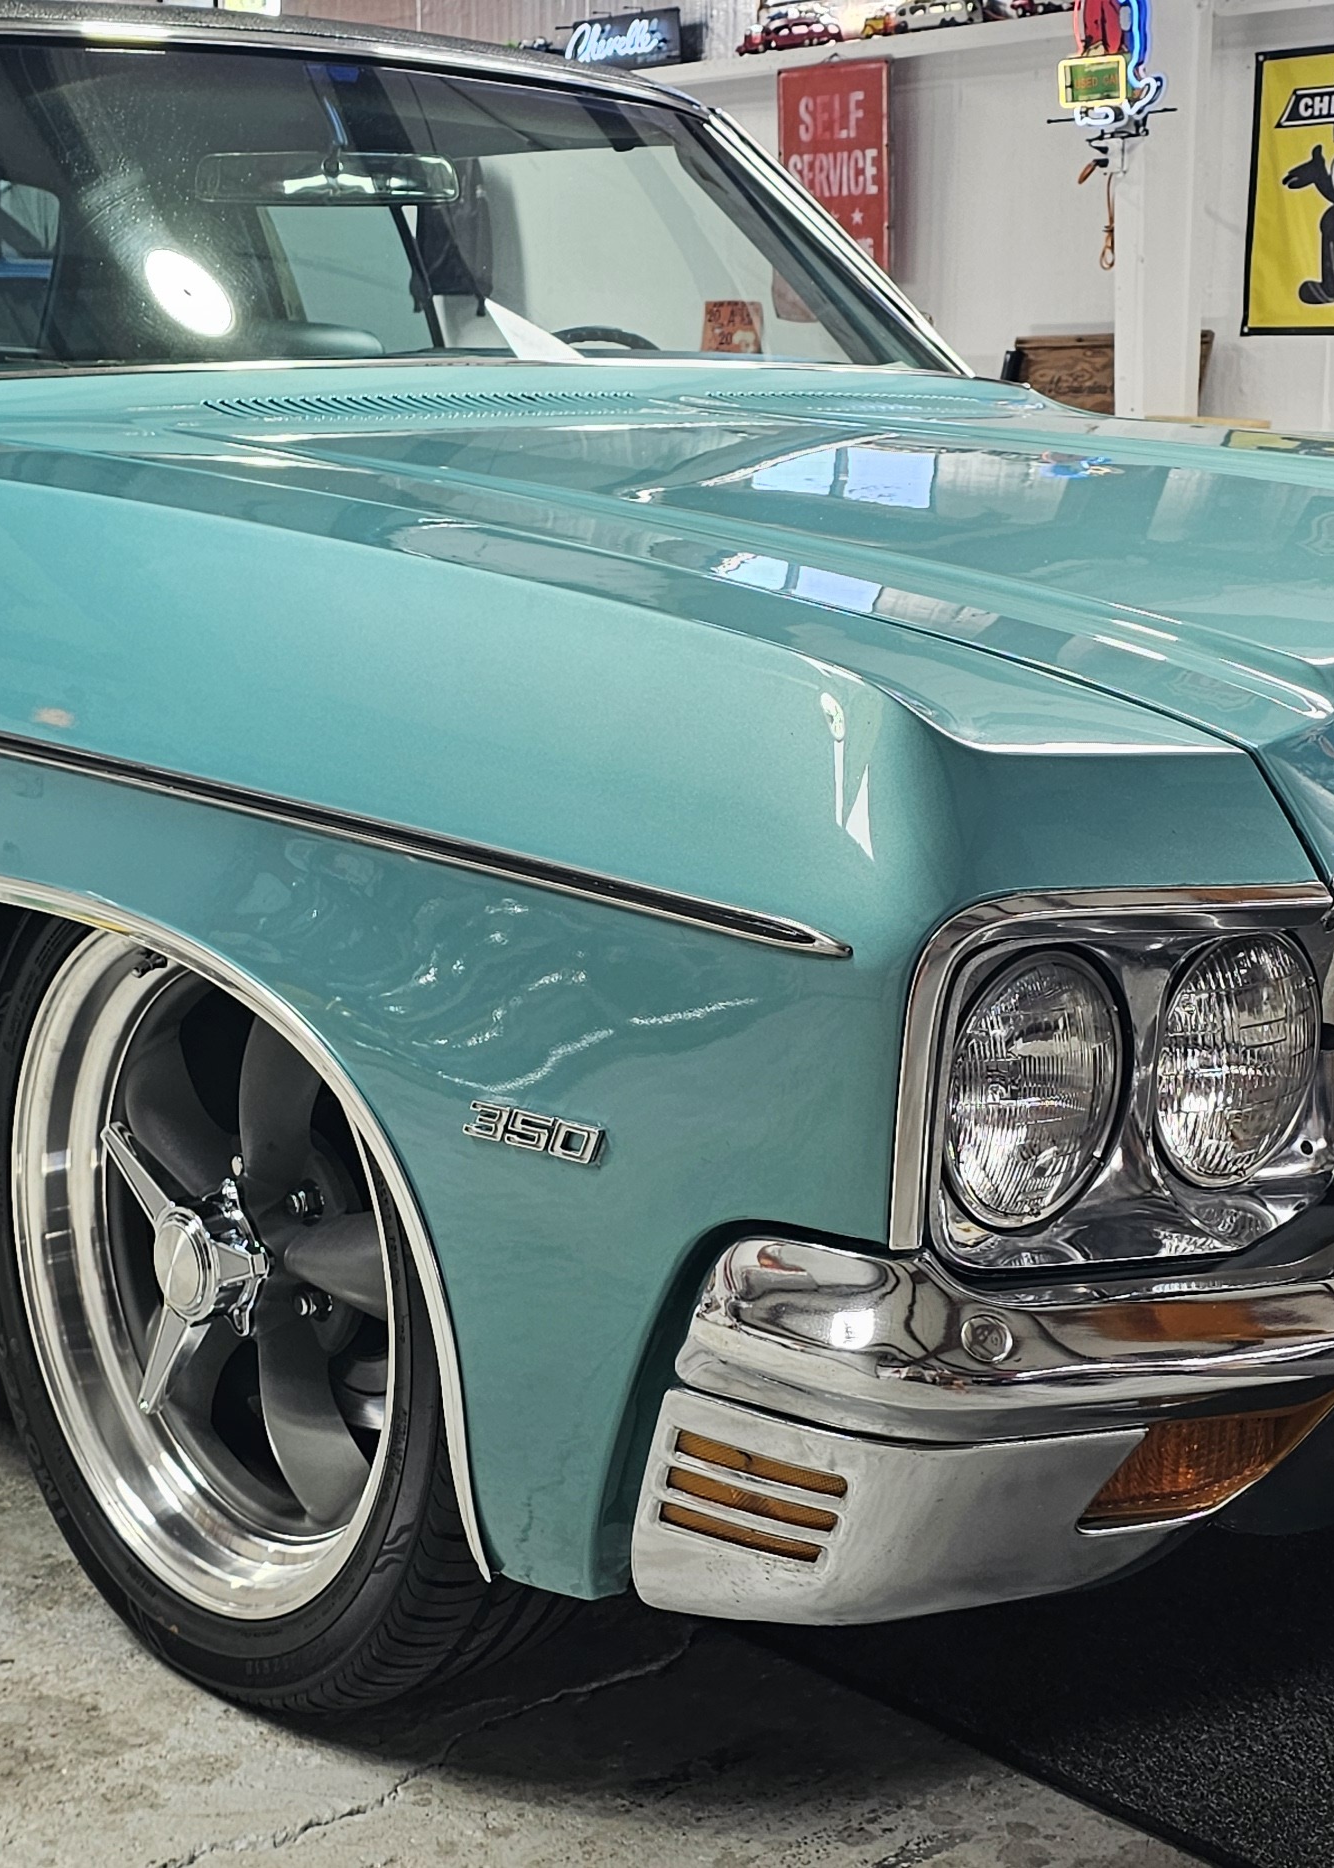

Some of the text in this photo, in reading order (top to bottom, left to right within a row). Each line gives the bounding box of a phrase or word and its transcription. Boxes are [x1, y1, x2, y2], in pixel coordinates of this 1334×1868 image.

[798, 90, 865, 142] SELF
[788, 148, 879, 198] SERVICE
[462, 1100, 605, 1166] 350
